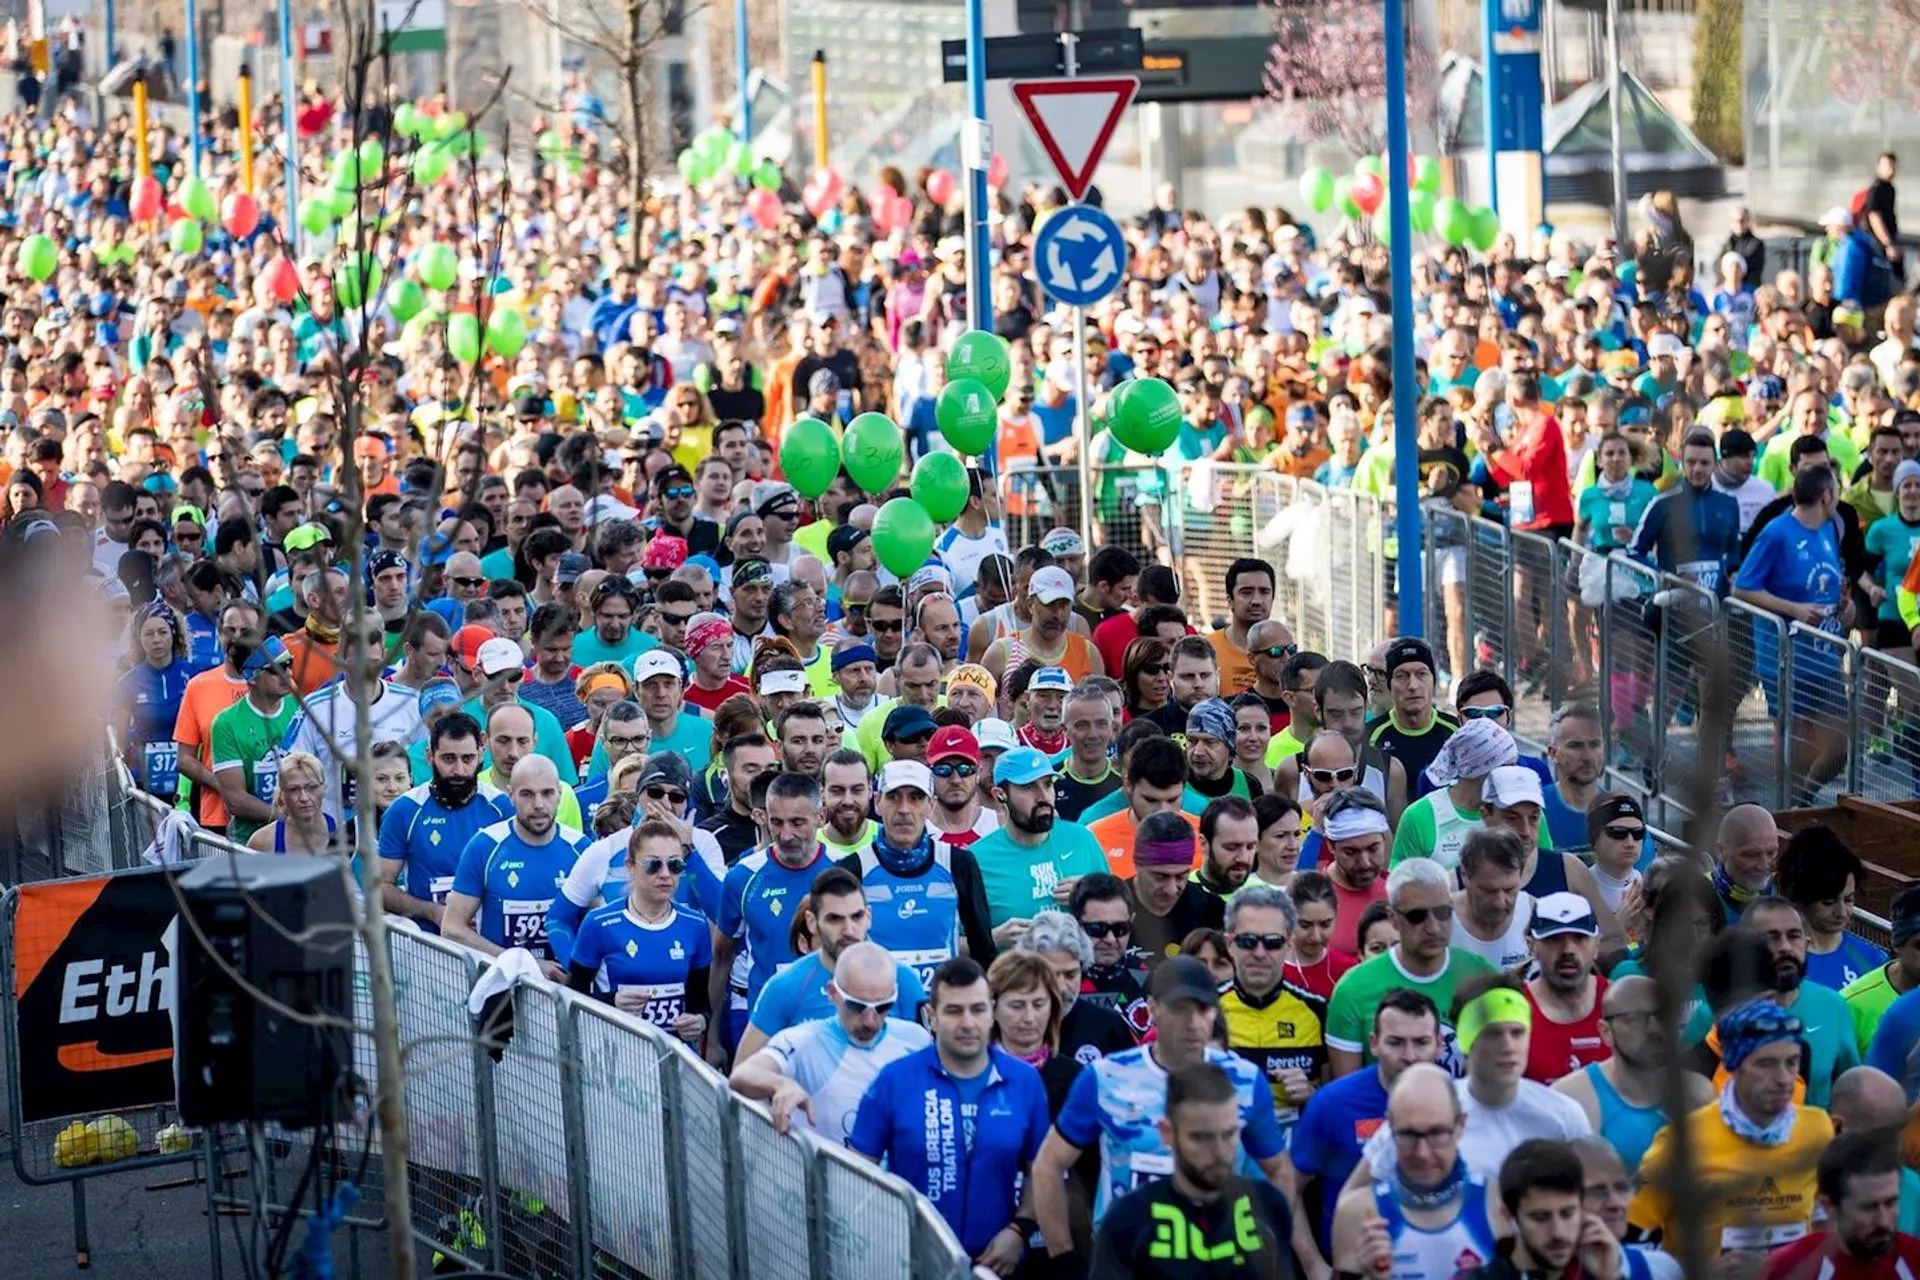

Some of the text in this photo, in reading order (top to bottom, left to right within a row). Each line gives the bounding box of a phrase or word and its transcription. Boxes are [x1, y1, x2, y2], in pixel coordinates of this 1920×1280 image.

[1029, 861, 1054, 877] RUN
[642, 1000, 681, 1024] 555
[1266, 1055, 1313, 1069] beretta
[924, 1088, 941, 1201] CUS BRESCIA
[939, 1098, 957, 1192] TRIATHLON
